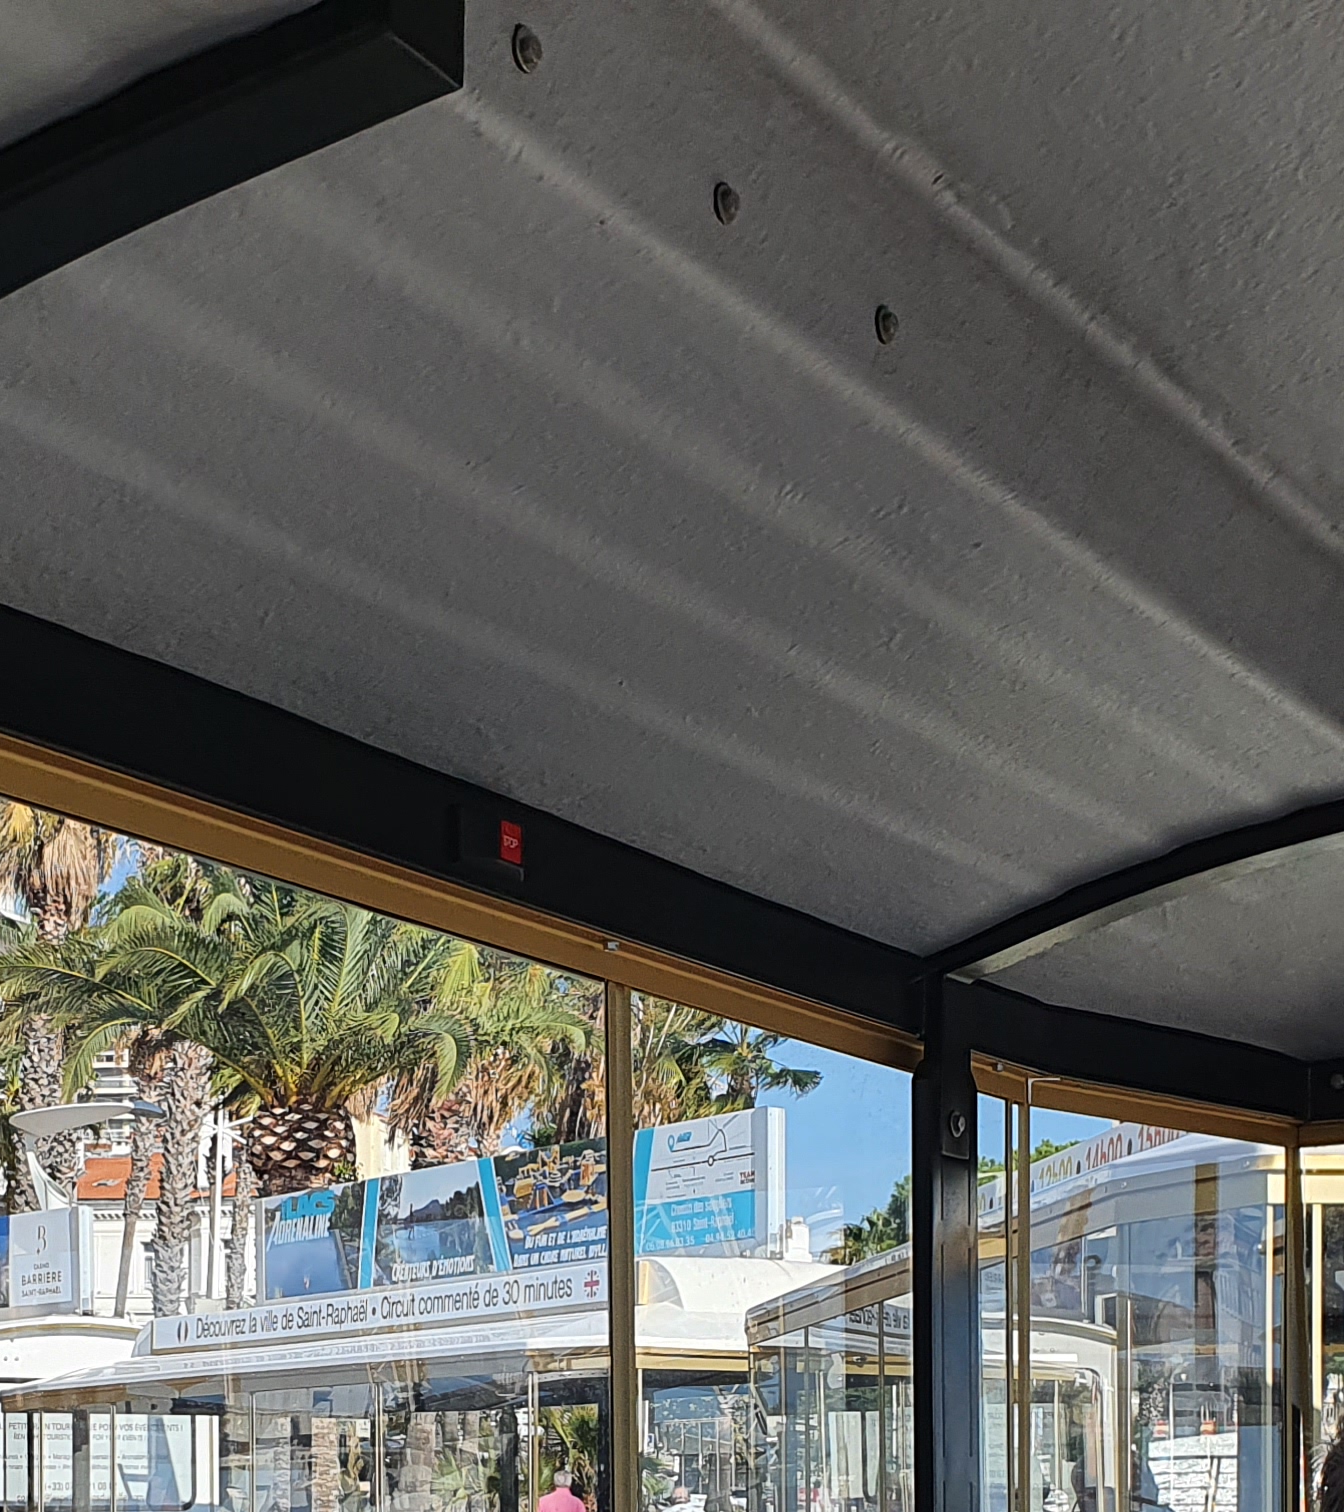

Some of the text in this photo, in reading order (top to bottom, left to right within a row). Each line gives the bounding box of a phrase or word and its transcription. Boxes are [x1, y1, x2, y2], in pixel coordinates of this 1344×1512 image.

[1039, 1155, 1073, 1188] 12h00
[1085, 1133, 1123, 1171] 14h00
[196, 1275, 573, 1340] Découvrez la ville de Saint-Raphaël Circuit commenté de 30 minutes
[120, 1423, 134, 1431] VOS
